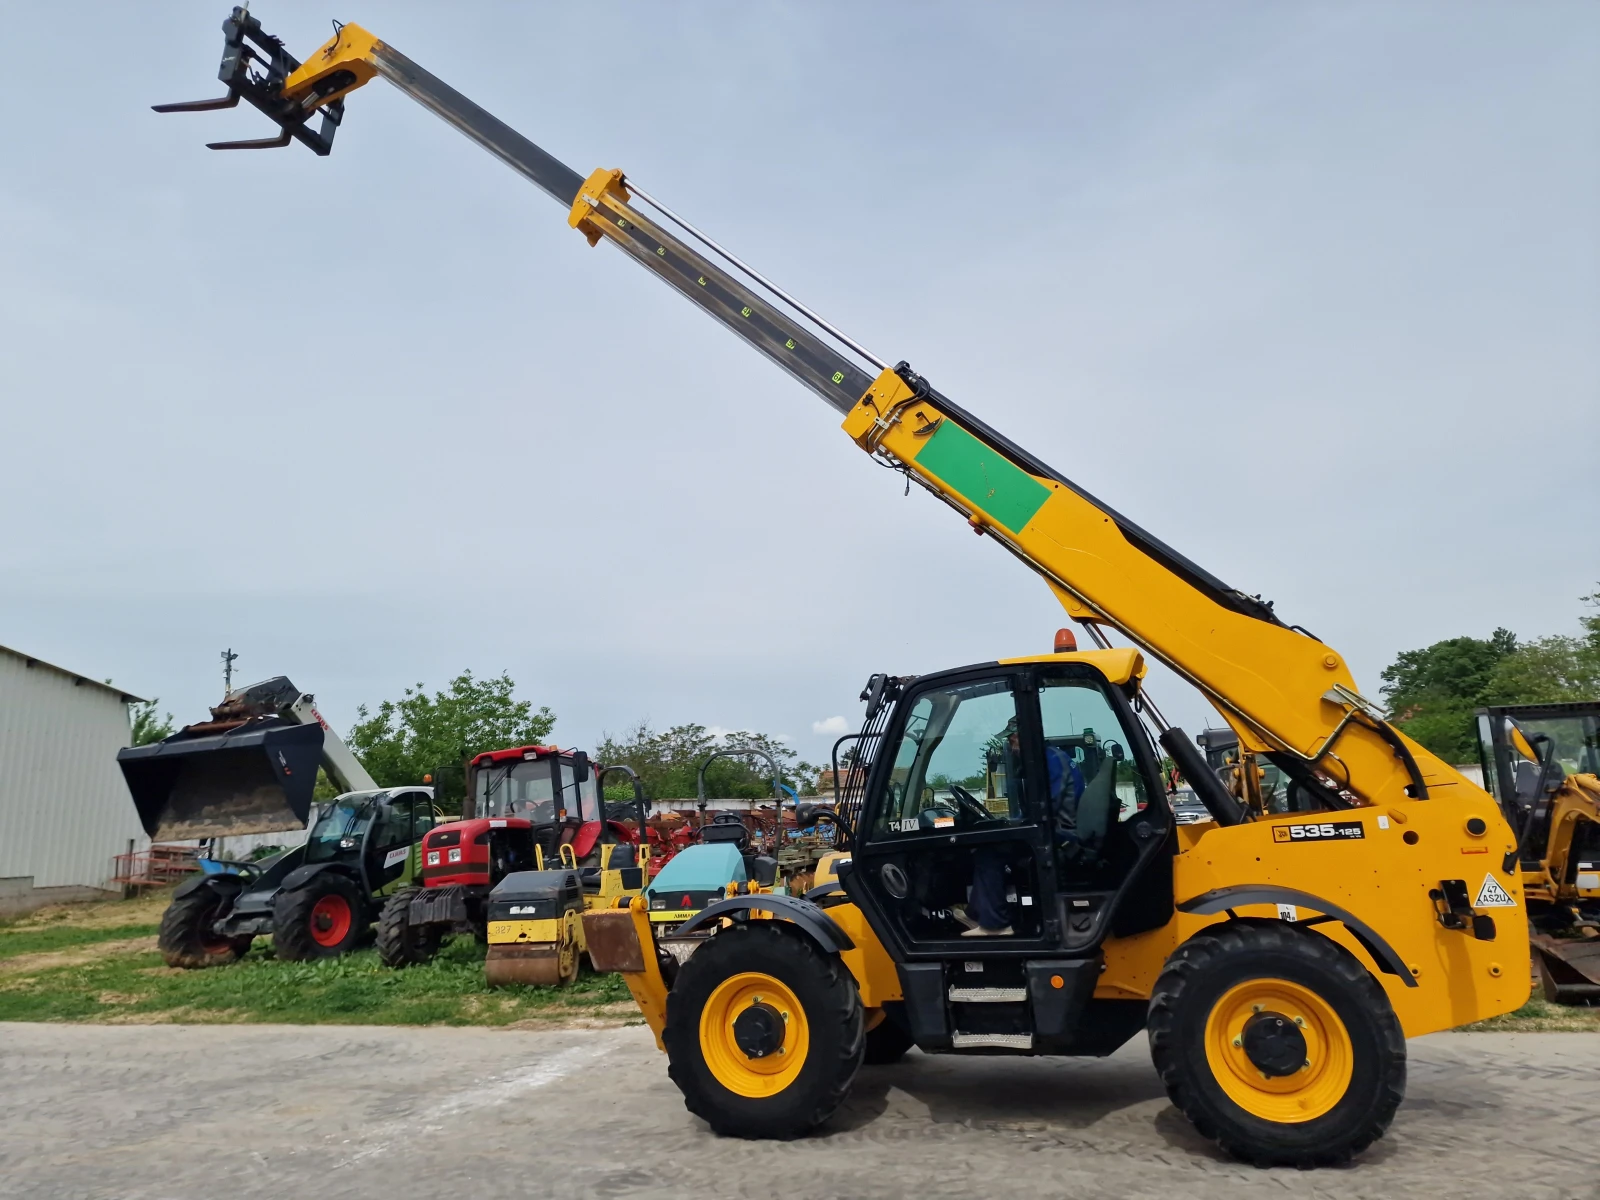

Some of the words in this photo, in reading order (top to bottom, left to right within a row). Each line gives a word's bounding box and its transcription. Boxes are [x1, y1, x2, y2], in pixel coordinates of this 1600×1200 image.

[311, 709, 328, 730] CLAAS
[888, 821, 901, 831] T4
[904, 820, 917, 831] IV
[389, 848, 407, 859] CLAAS
[1483, 894, 1506, 903] AS2U
